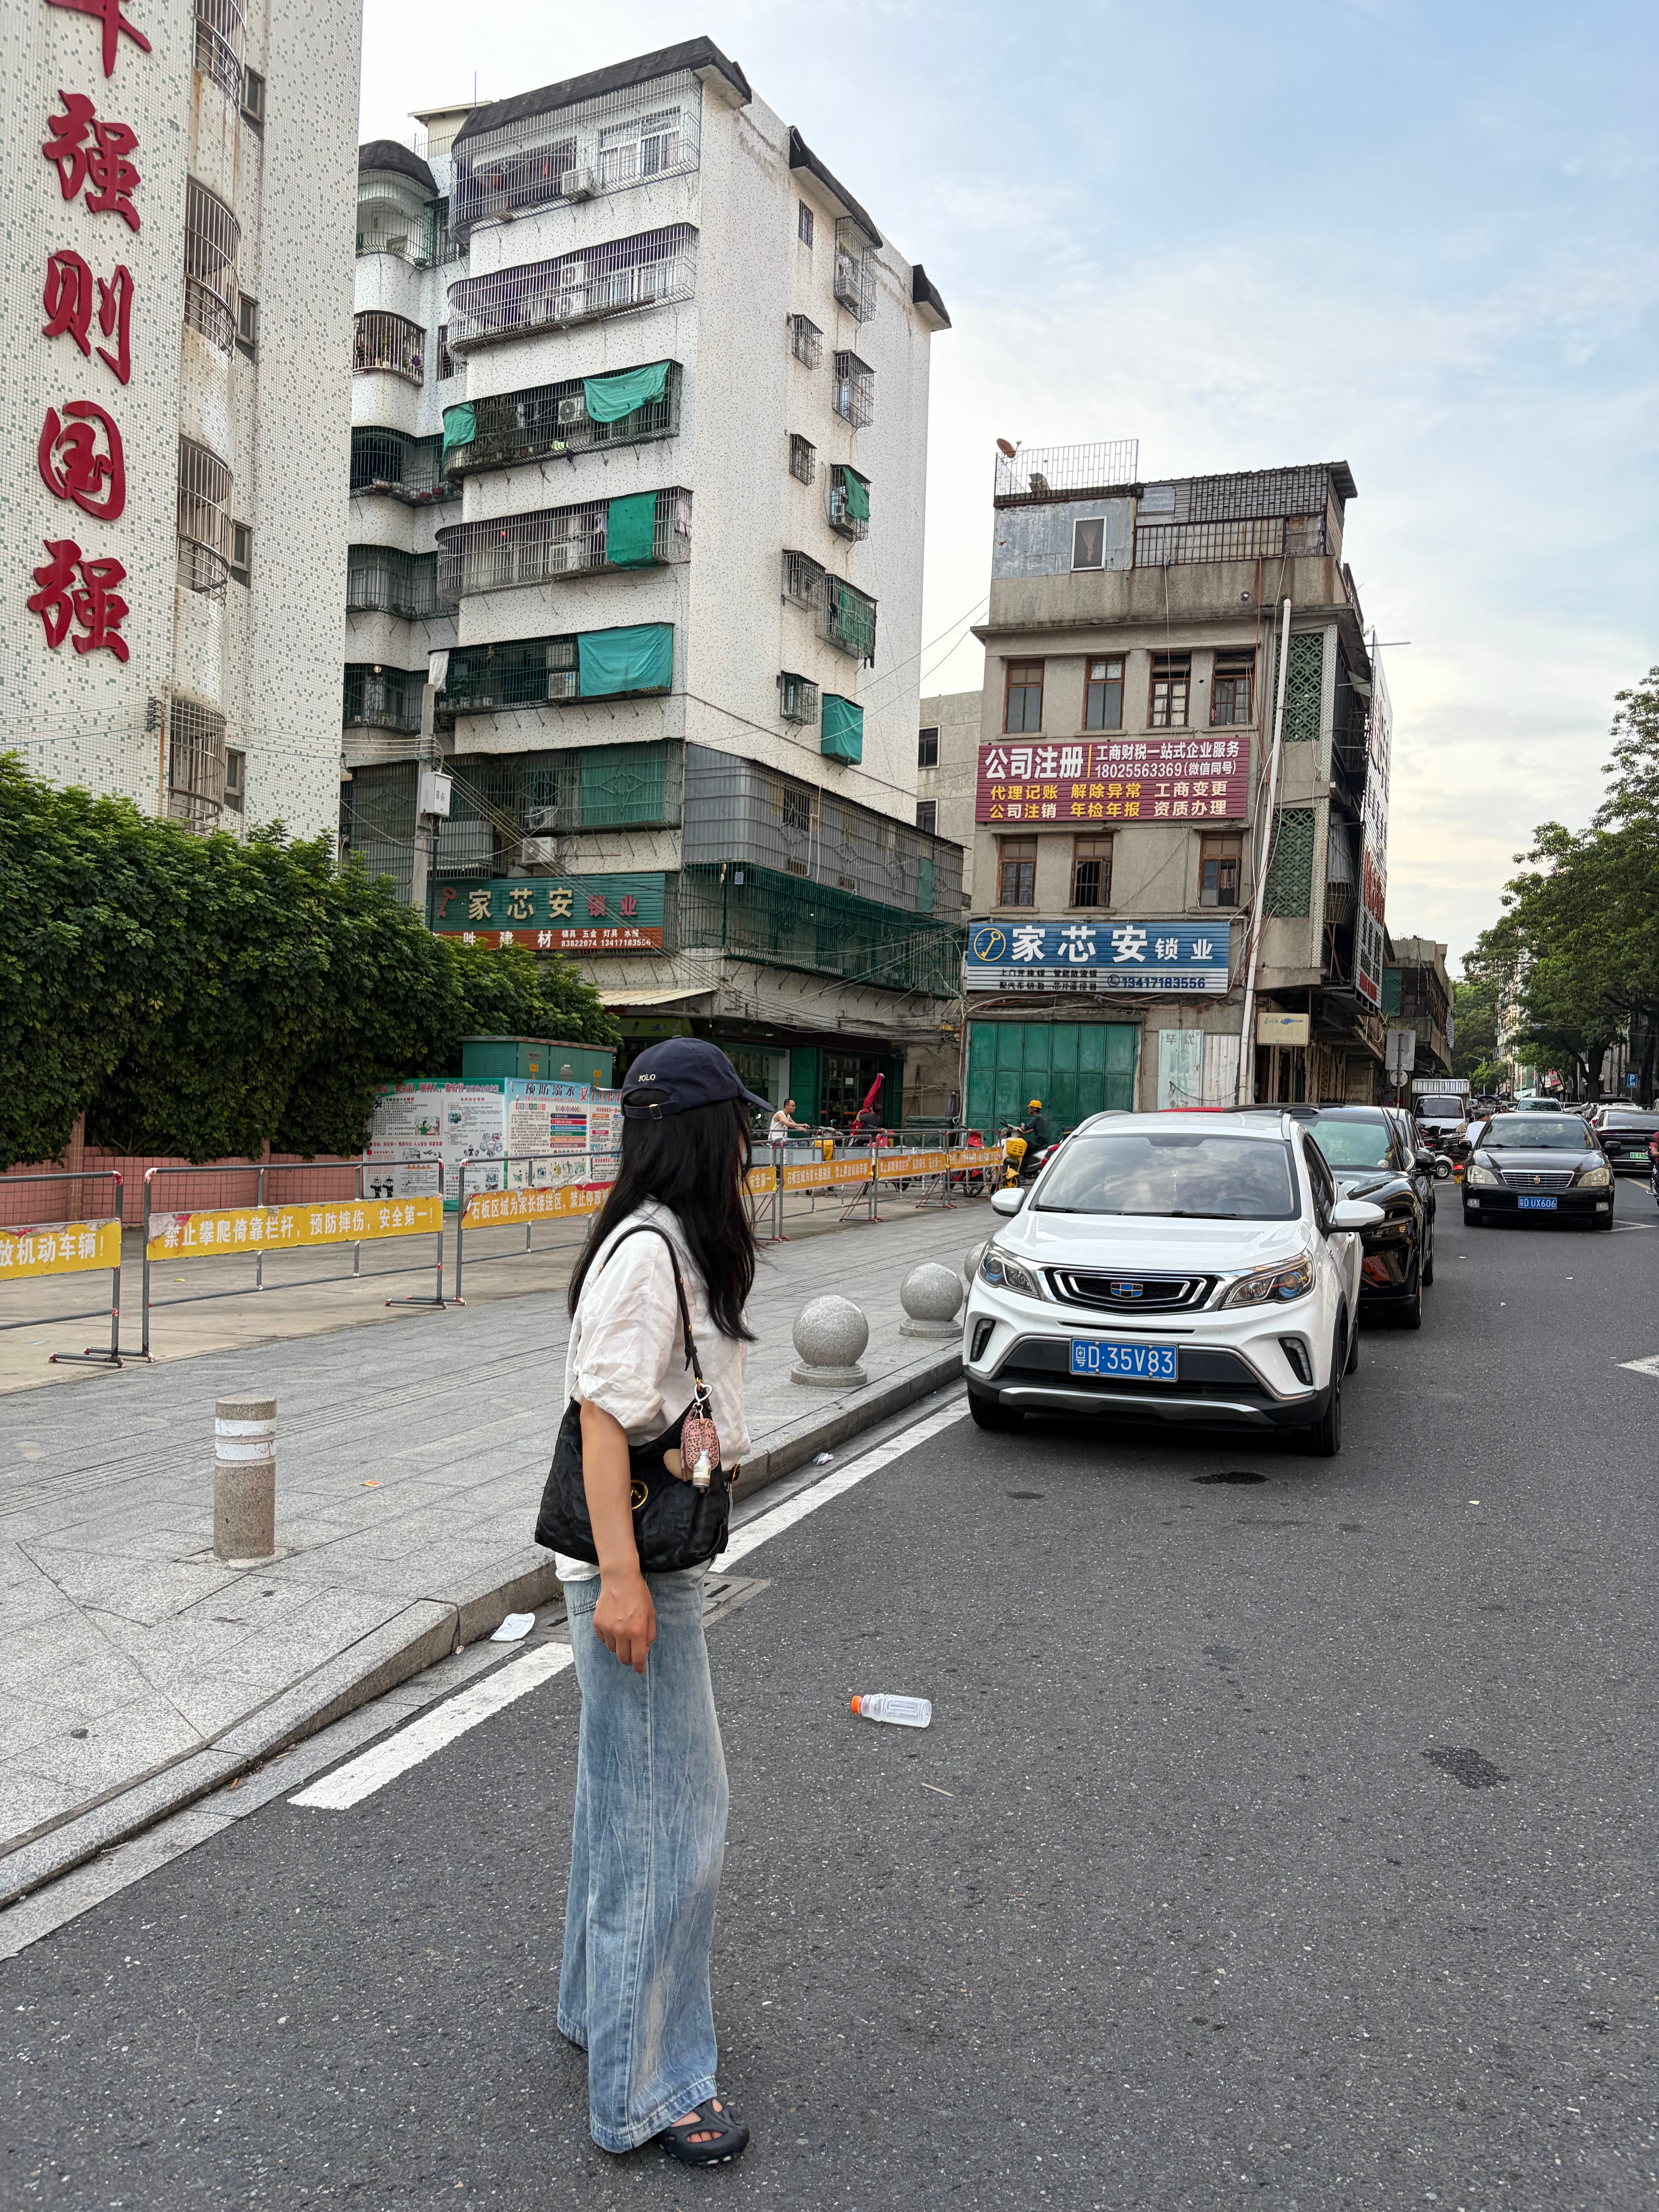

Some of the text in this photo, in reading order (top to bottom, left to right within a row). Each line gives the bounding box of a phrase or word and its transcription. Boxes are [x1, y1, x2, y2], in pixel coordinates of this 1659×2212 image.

[1096, 740, 1240, 761] 工商财税一站式企业服务
[985, 746, 1084, 780] 公司注册
[991, 780, 1228, 801] 代理记账 解除异常 工商变更
[989, 800, 1227, 819] 公司注销 年检年报 资质办理
[468, 887, 573, 921] 家芯安
[582, 929, 597, 938] 五金
[603, 929, 618, 938] 灯具
[1010, 925, 1212, 963] 家芯安 锁业
[1123, 977, 1206, 989] 13417183556
[525, 1083, 575, 1097] 预防溺水
